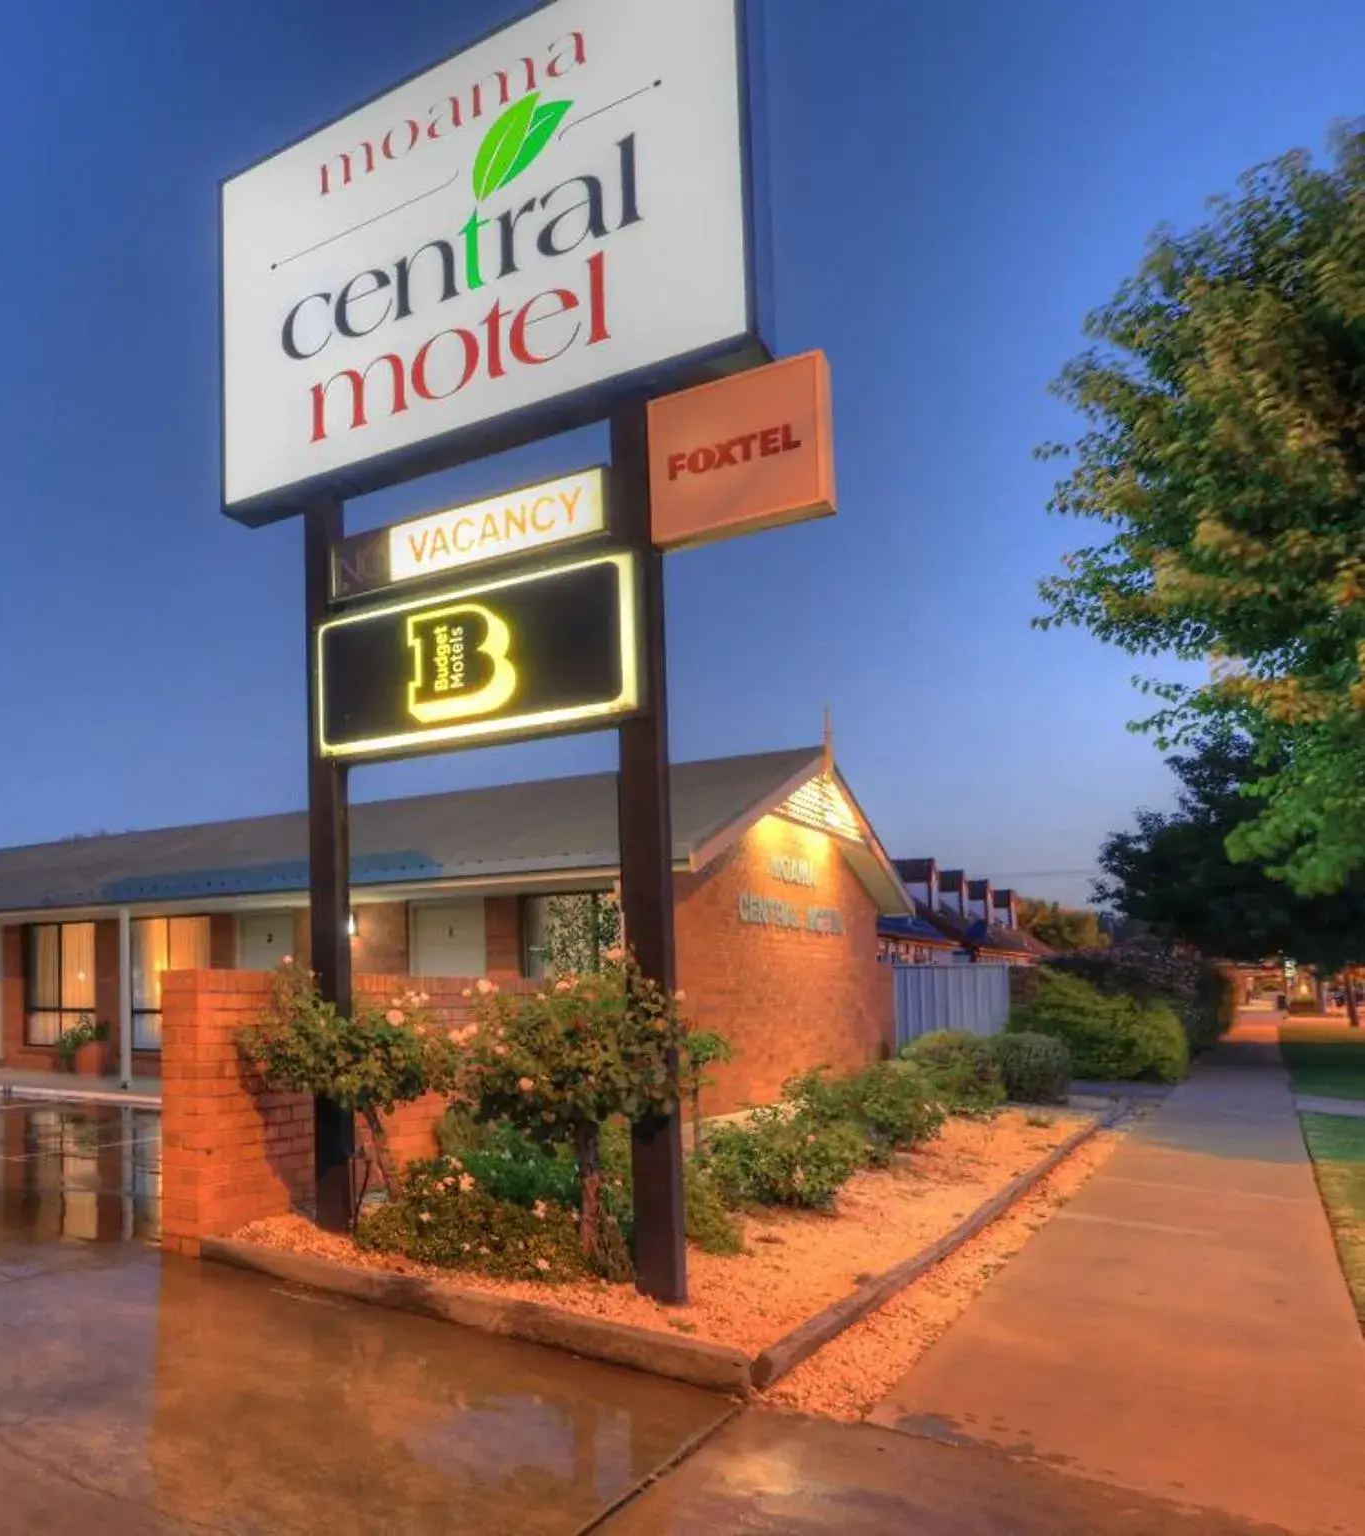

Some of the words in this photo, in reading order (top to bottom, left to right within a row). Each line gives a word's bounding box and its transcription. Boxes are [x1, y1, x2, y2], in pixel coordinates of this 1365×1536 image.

[320, 29, 587, 196] moama
[281, 131, 644, 361] central
[309, 250, 613, 444] motel
[668, 423, 803, 481] FOXTEL
[408, 485, 583, 564] VACANCY
[434, 625, 449, 691] Budget
[450, 626, 464, 689] Motels
